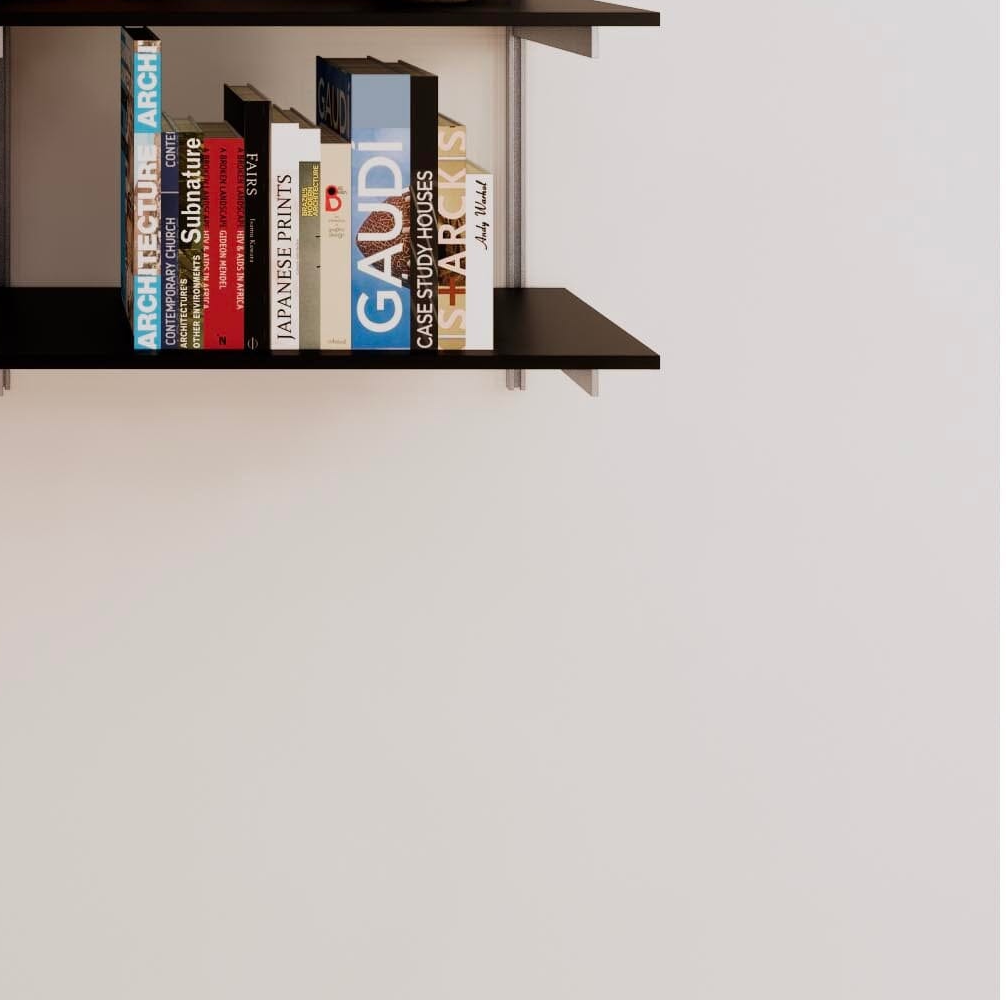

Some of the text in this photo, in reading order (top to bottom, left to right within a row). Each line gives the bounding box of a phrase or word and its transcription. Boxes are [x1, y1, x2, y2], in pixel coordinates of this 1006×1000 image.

[164, 131, 177, 168] CONTE
[246, 152, 259, 197] FAIRS
[180, 136, 202, 245] Subnature
[474, 180, 490, 251] Andy Warhol
[137, 144, 157, 349] ARCHITECTURE
[218, 230, 228, 259] GIDEON
[236, 230, 245, 244] HIV
[236, 253, 245, 271] AIDS
[276, 174, 295, 341] JAPANESE PRINTS
[417, 170, 433, 349] CASE STUDY HOUSES
[164, 216, 177, 346] CONTEMPORARY CHURCH
[192, 254, 201, 349] OTHER ENVIRONMENTS
[218, 260, 228, 290] MENDEL
[236, 282, 245, 310] AFRICA
[179, 278, 189, 349] ARCHITECTURE'S
